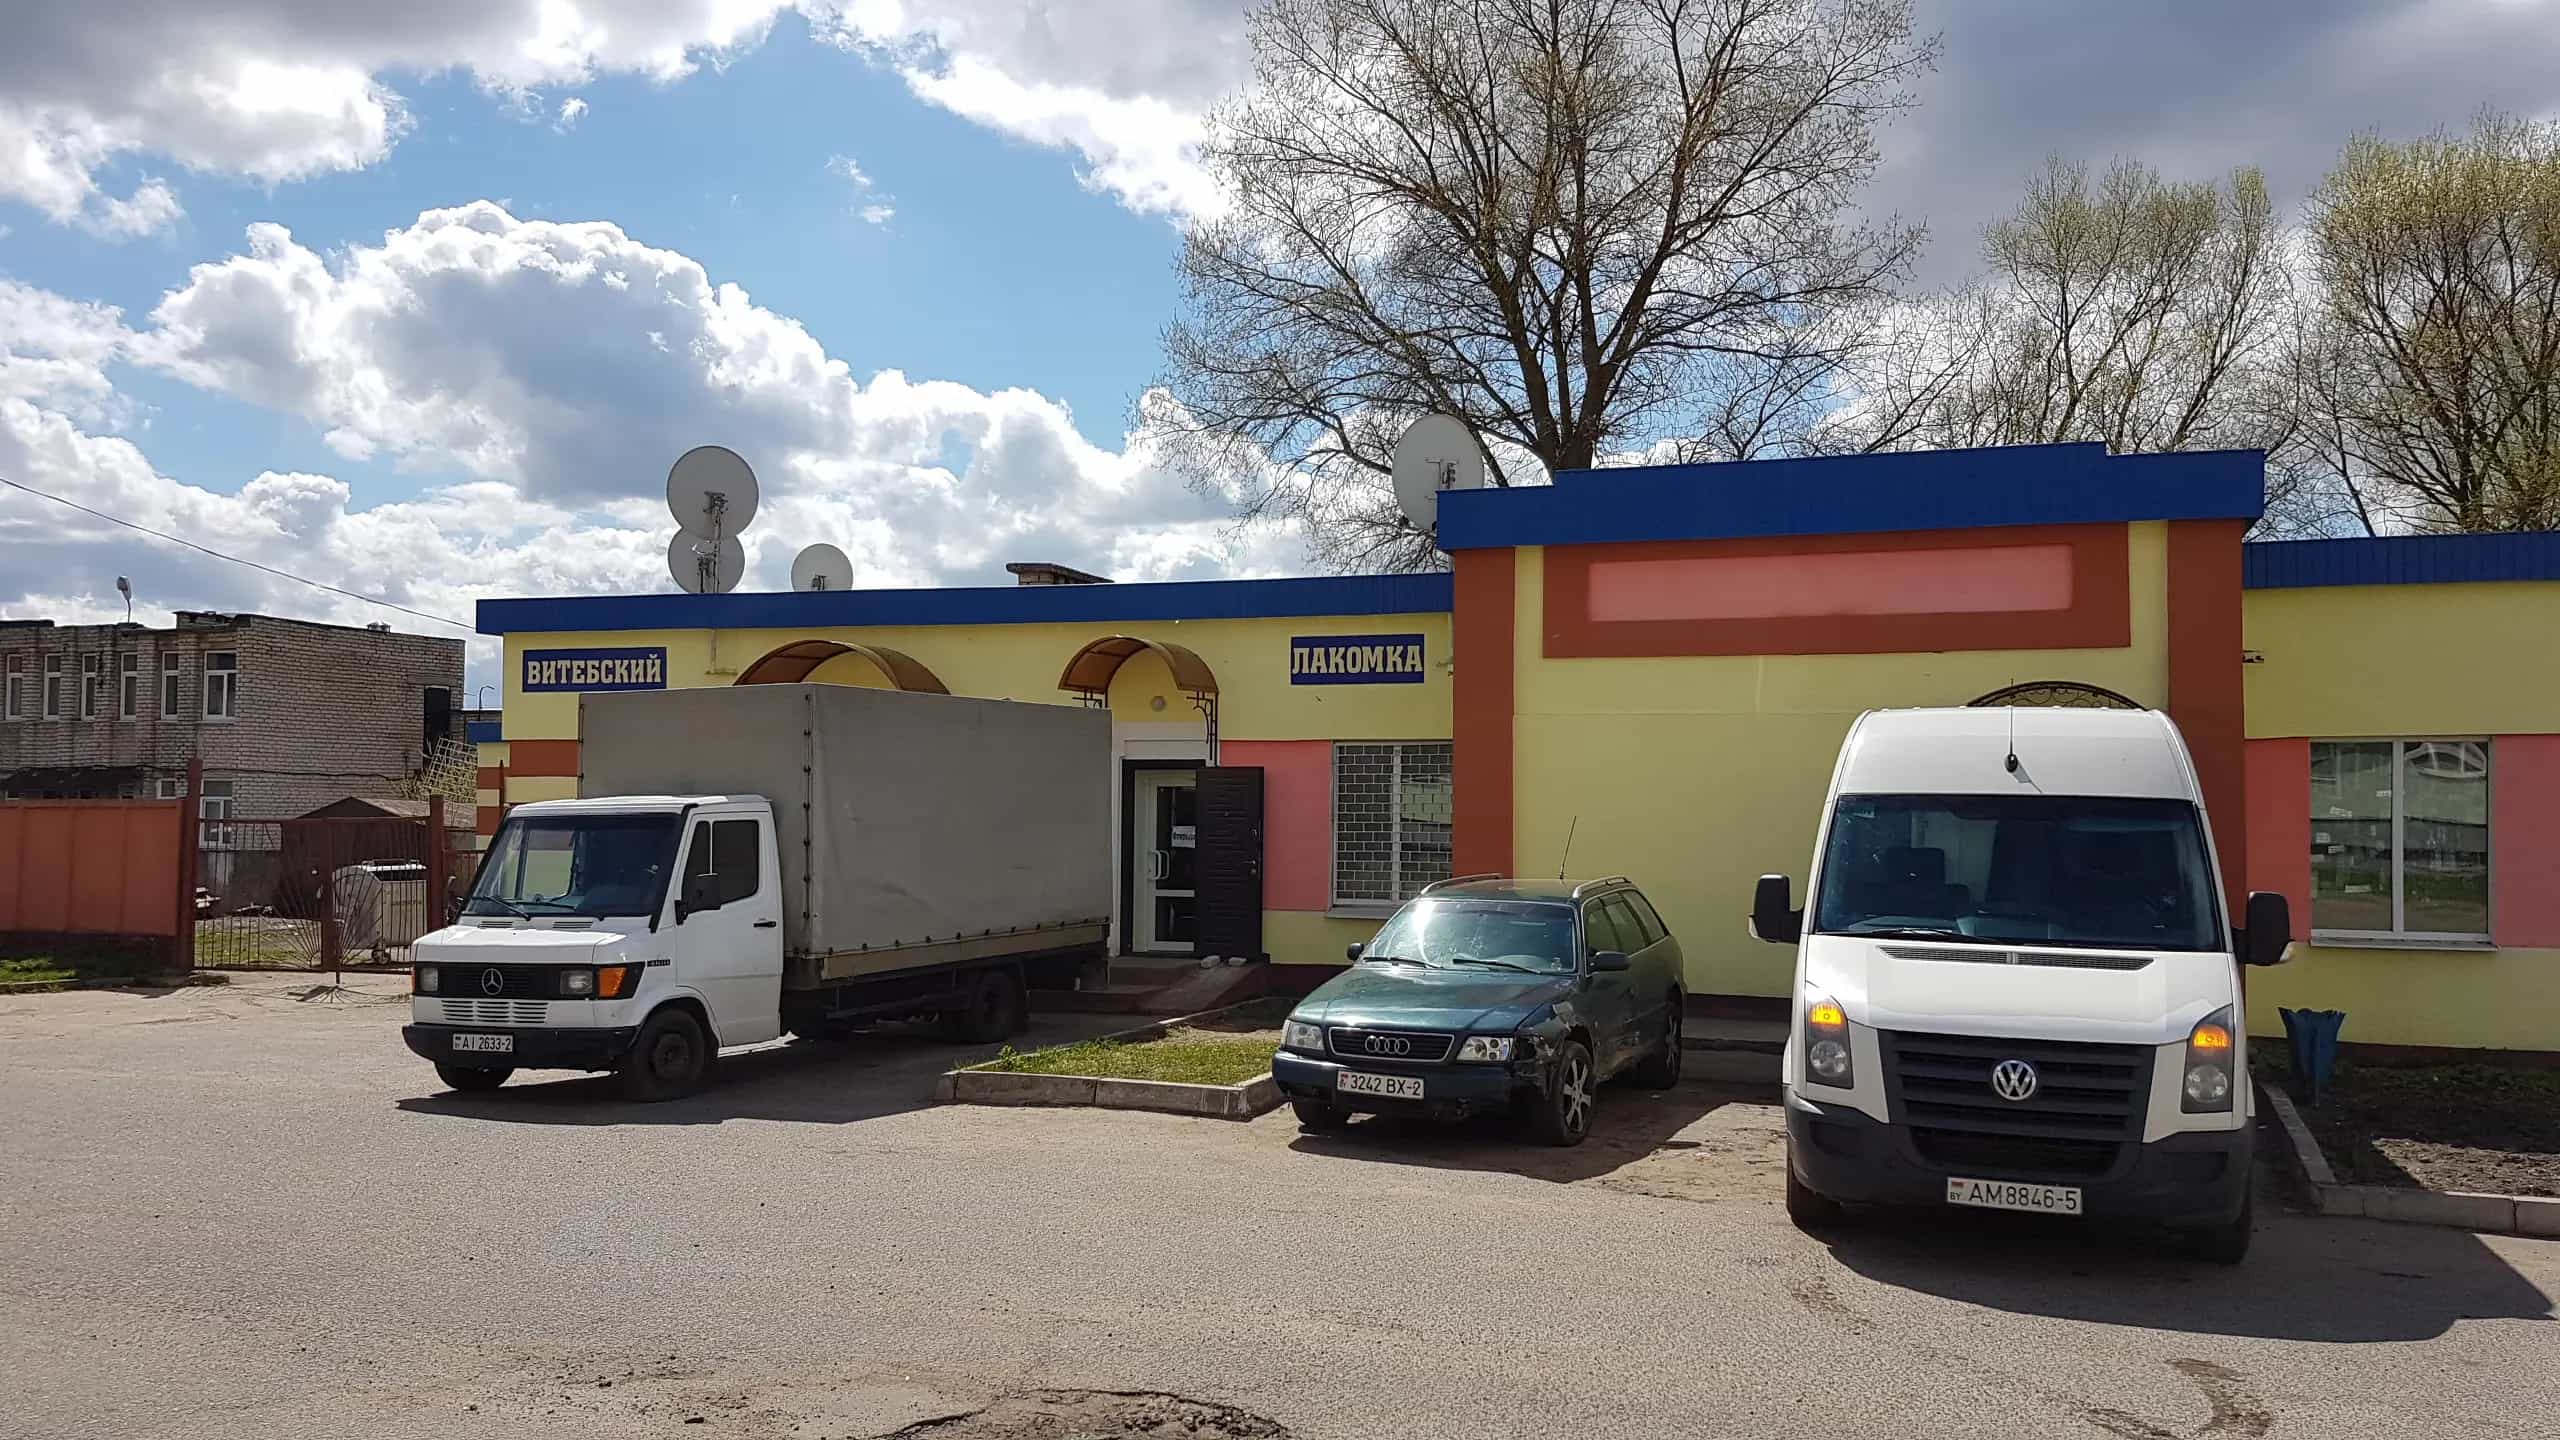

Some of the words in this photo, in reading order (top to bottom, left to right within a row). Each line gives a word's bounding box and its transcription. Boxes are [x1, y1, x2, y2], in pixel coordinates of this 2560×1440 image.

[527, 653, 662, 685] ВИТЕБСКИЙ
[1292, 645, 1423, 674] ЛАКОМКА
[1350, 1074, 1382, 1092] 3242
[1386, 1078, 1421, 1096] BX-2
